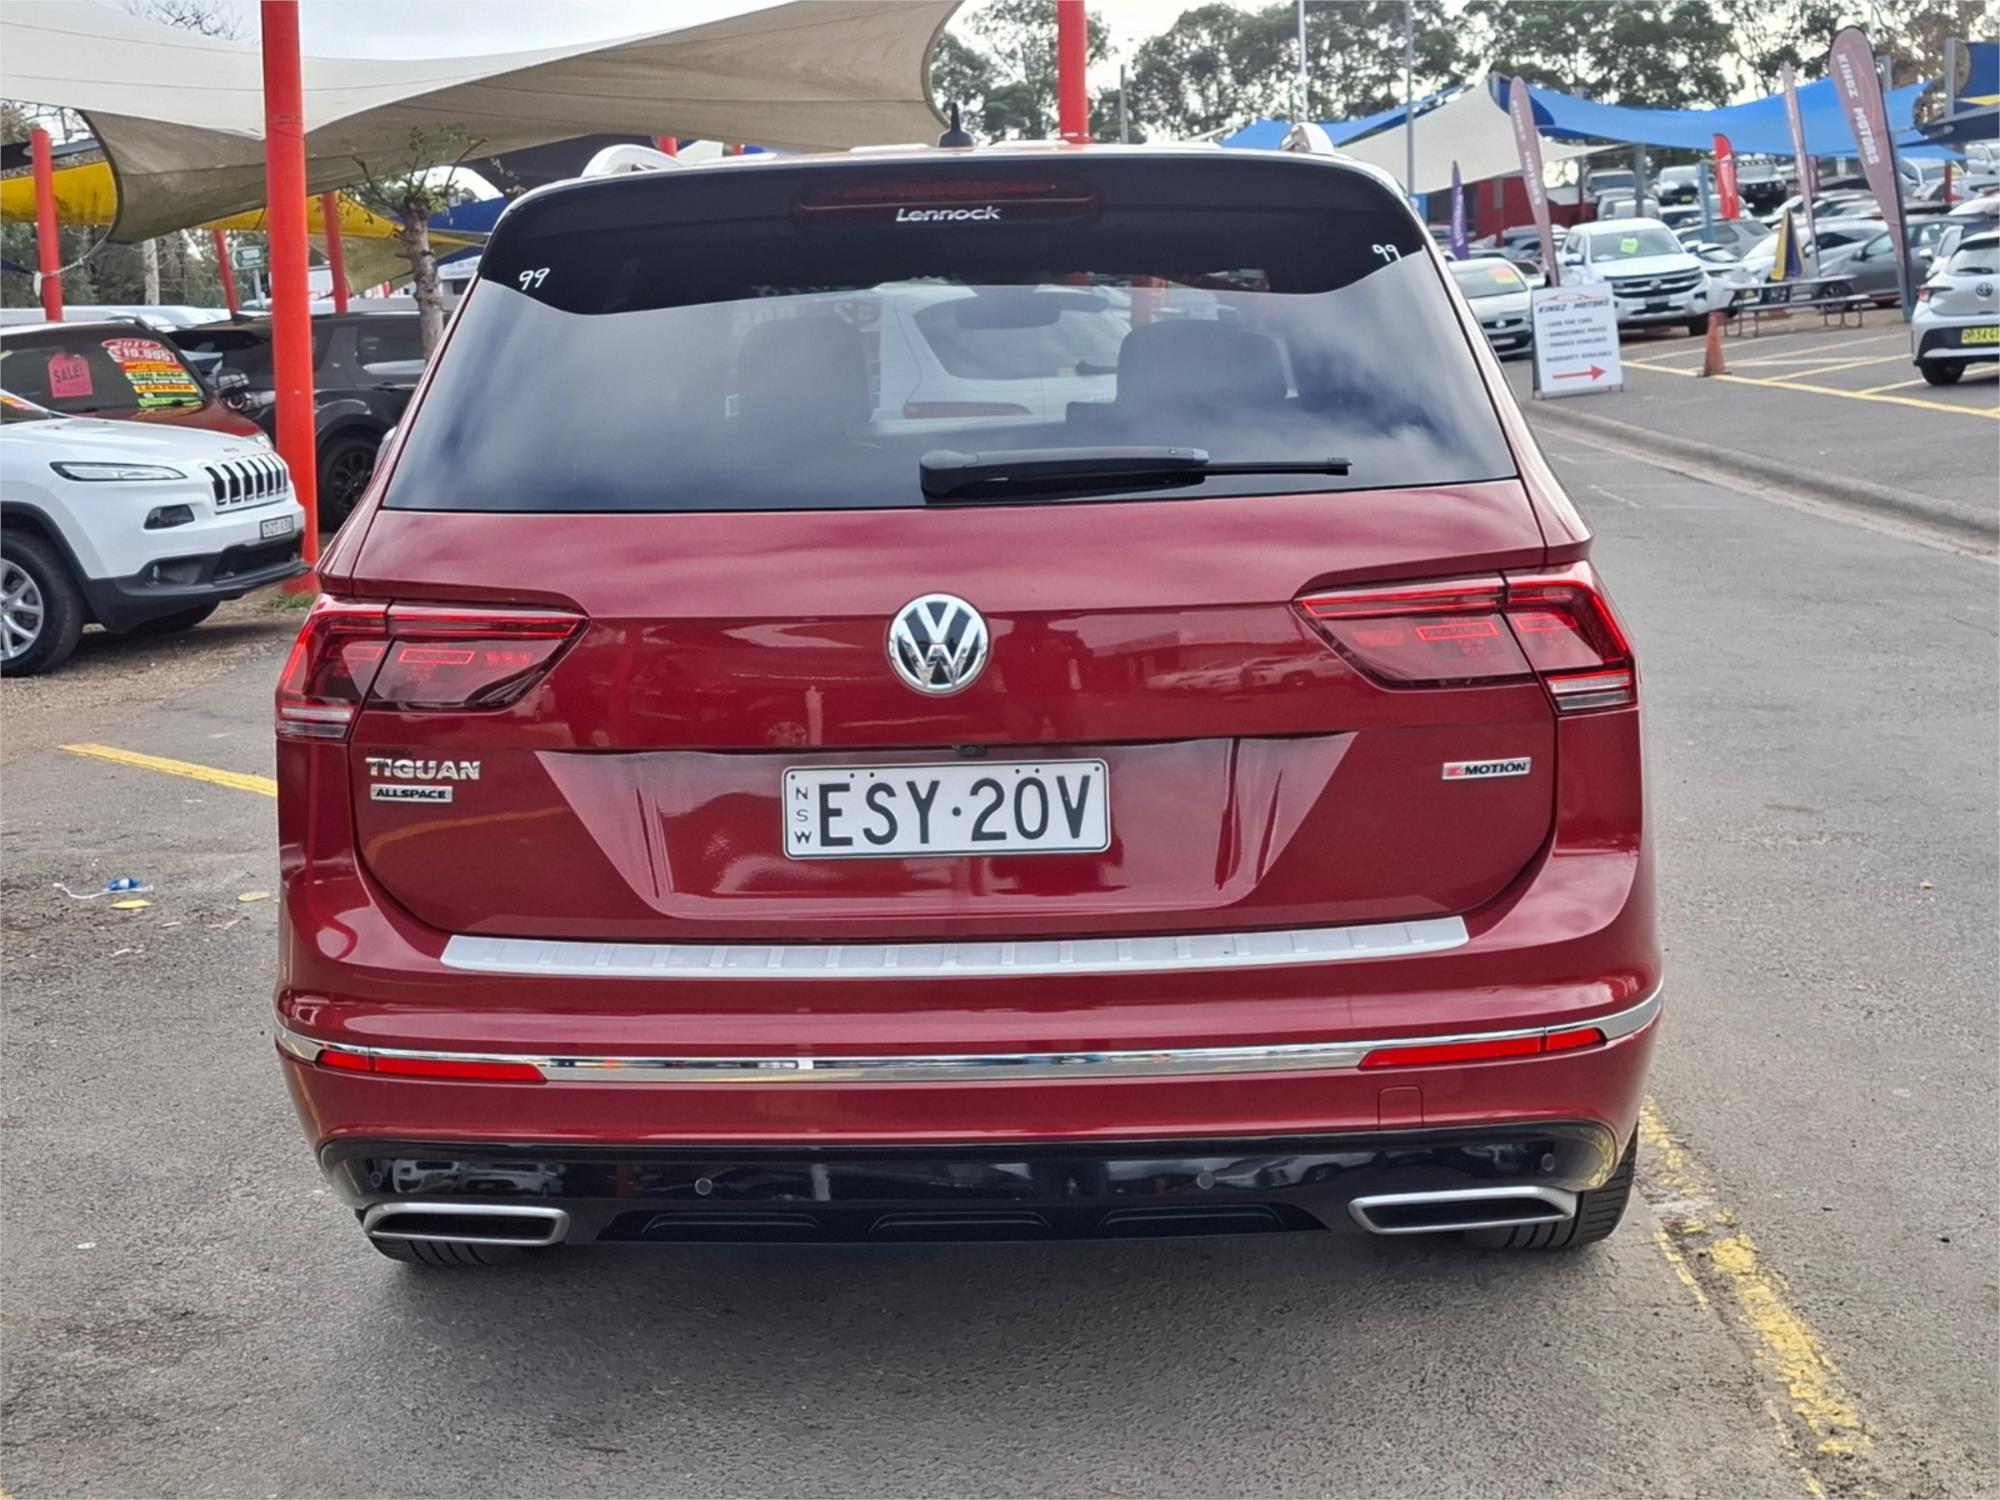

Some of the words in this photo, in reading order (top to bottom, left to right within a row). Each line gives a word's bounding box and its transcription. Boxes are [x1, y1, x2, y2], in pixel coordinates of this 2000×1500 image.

[1836, 53, 1859, 98] KINGZ
[1853, 107, 1880, 165] MOTORS
[895, 205, 1002, 222] Lennock
[1371, 243, 1402, 262] 99
[518, 267, 551, 291] 99
[365, 757, 481, 780] TIGUAN
[375, 788, 448, 799] ALLSPACE
